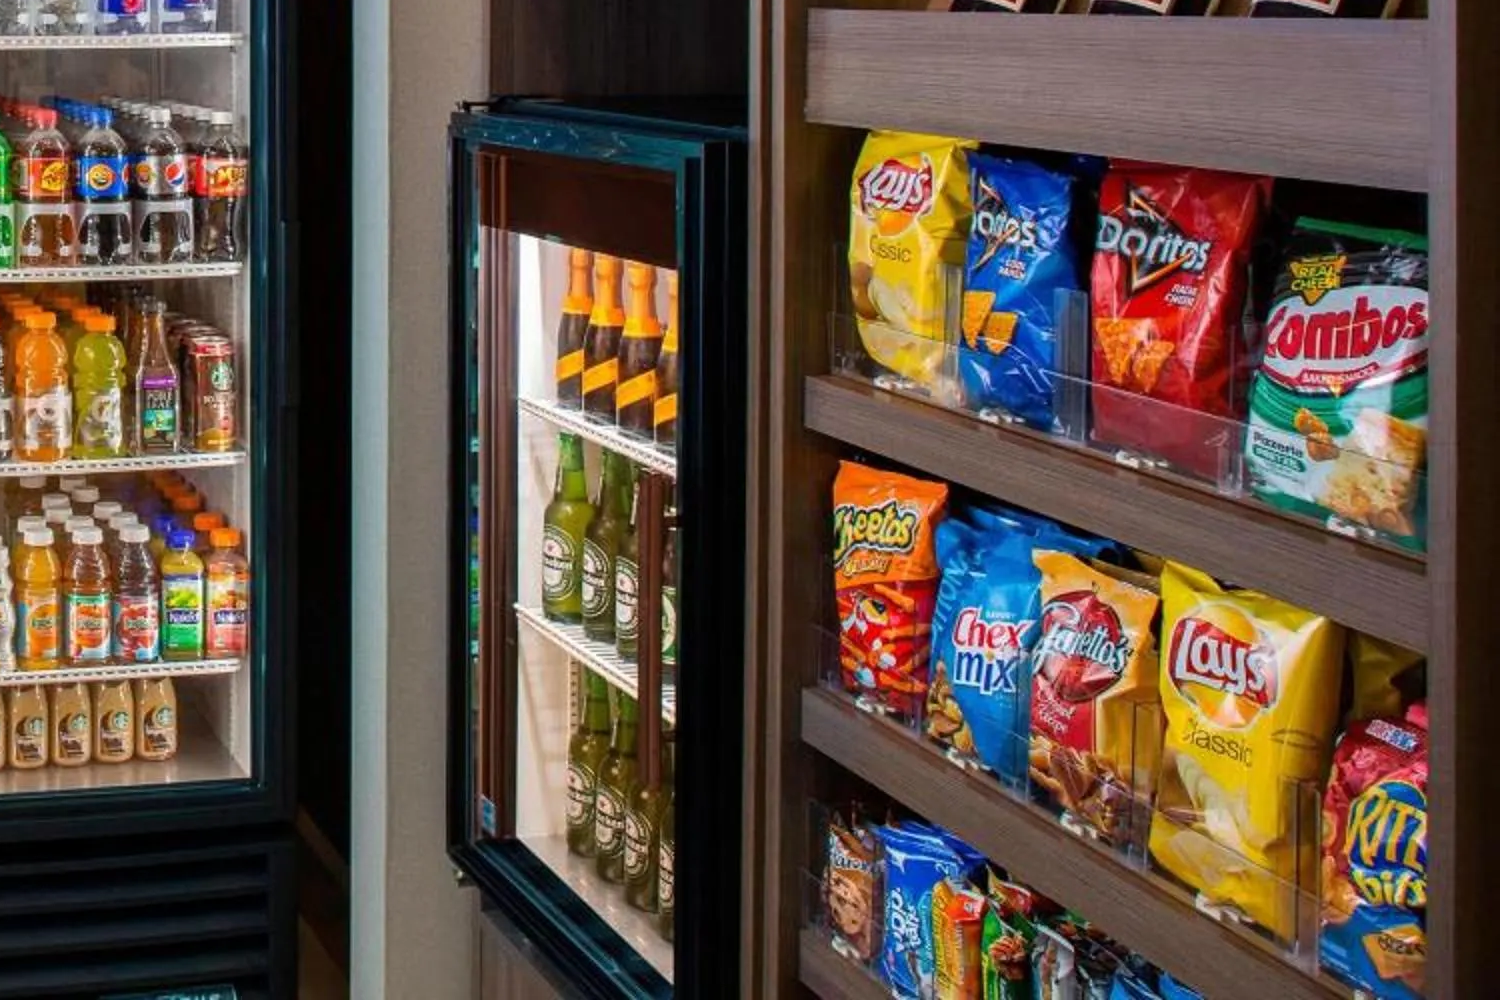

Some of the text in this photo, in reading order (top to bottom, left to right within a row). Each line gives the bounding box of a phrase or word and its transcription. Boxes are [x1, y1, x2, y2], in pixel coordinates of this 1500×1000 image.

[860, 163, 929, 209] Lay's
[1096, 214, 1211, 272] Doritos
[1263, 296, 1429, 361] Combos
[952, 606, 1034, 650] Chex
[954, 650, 1022, 696] mix
[1345, 784, 1428, 873] RITZ
